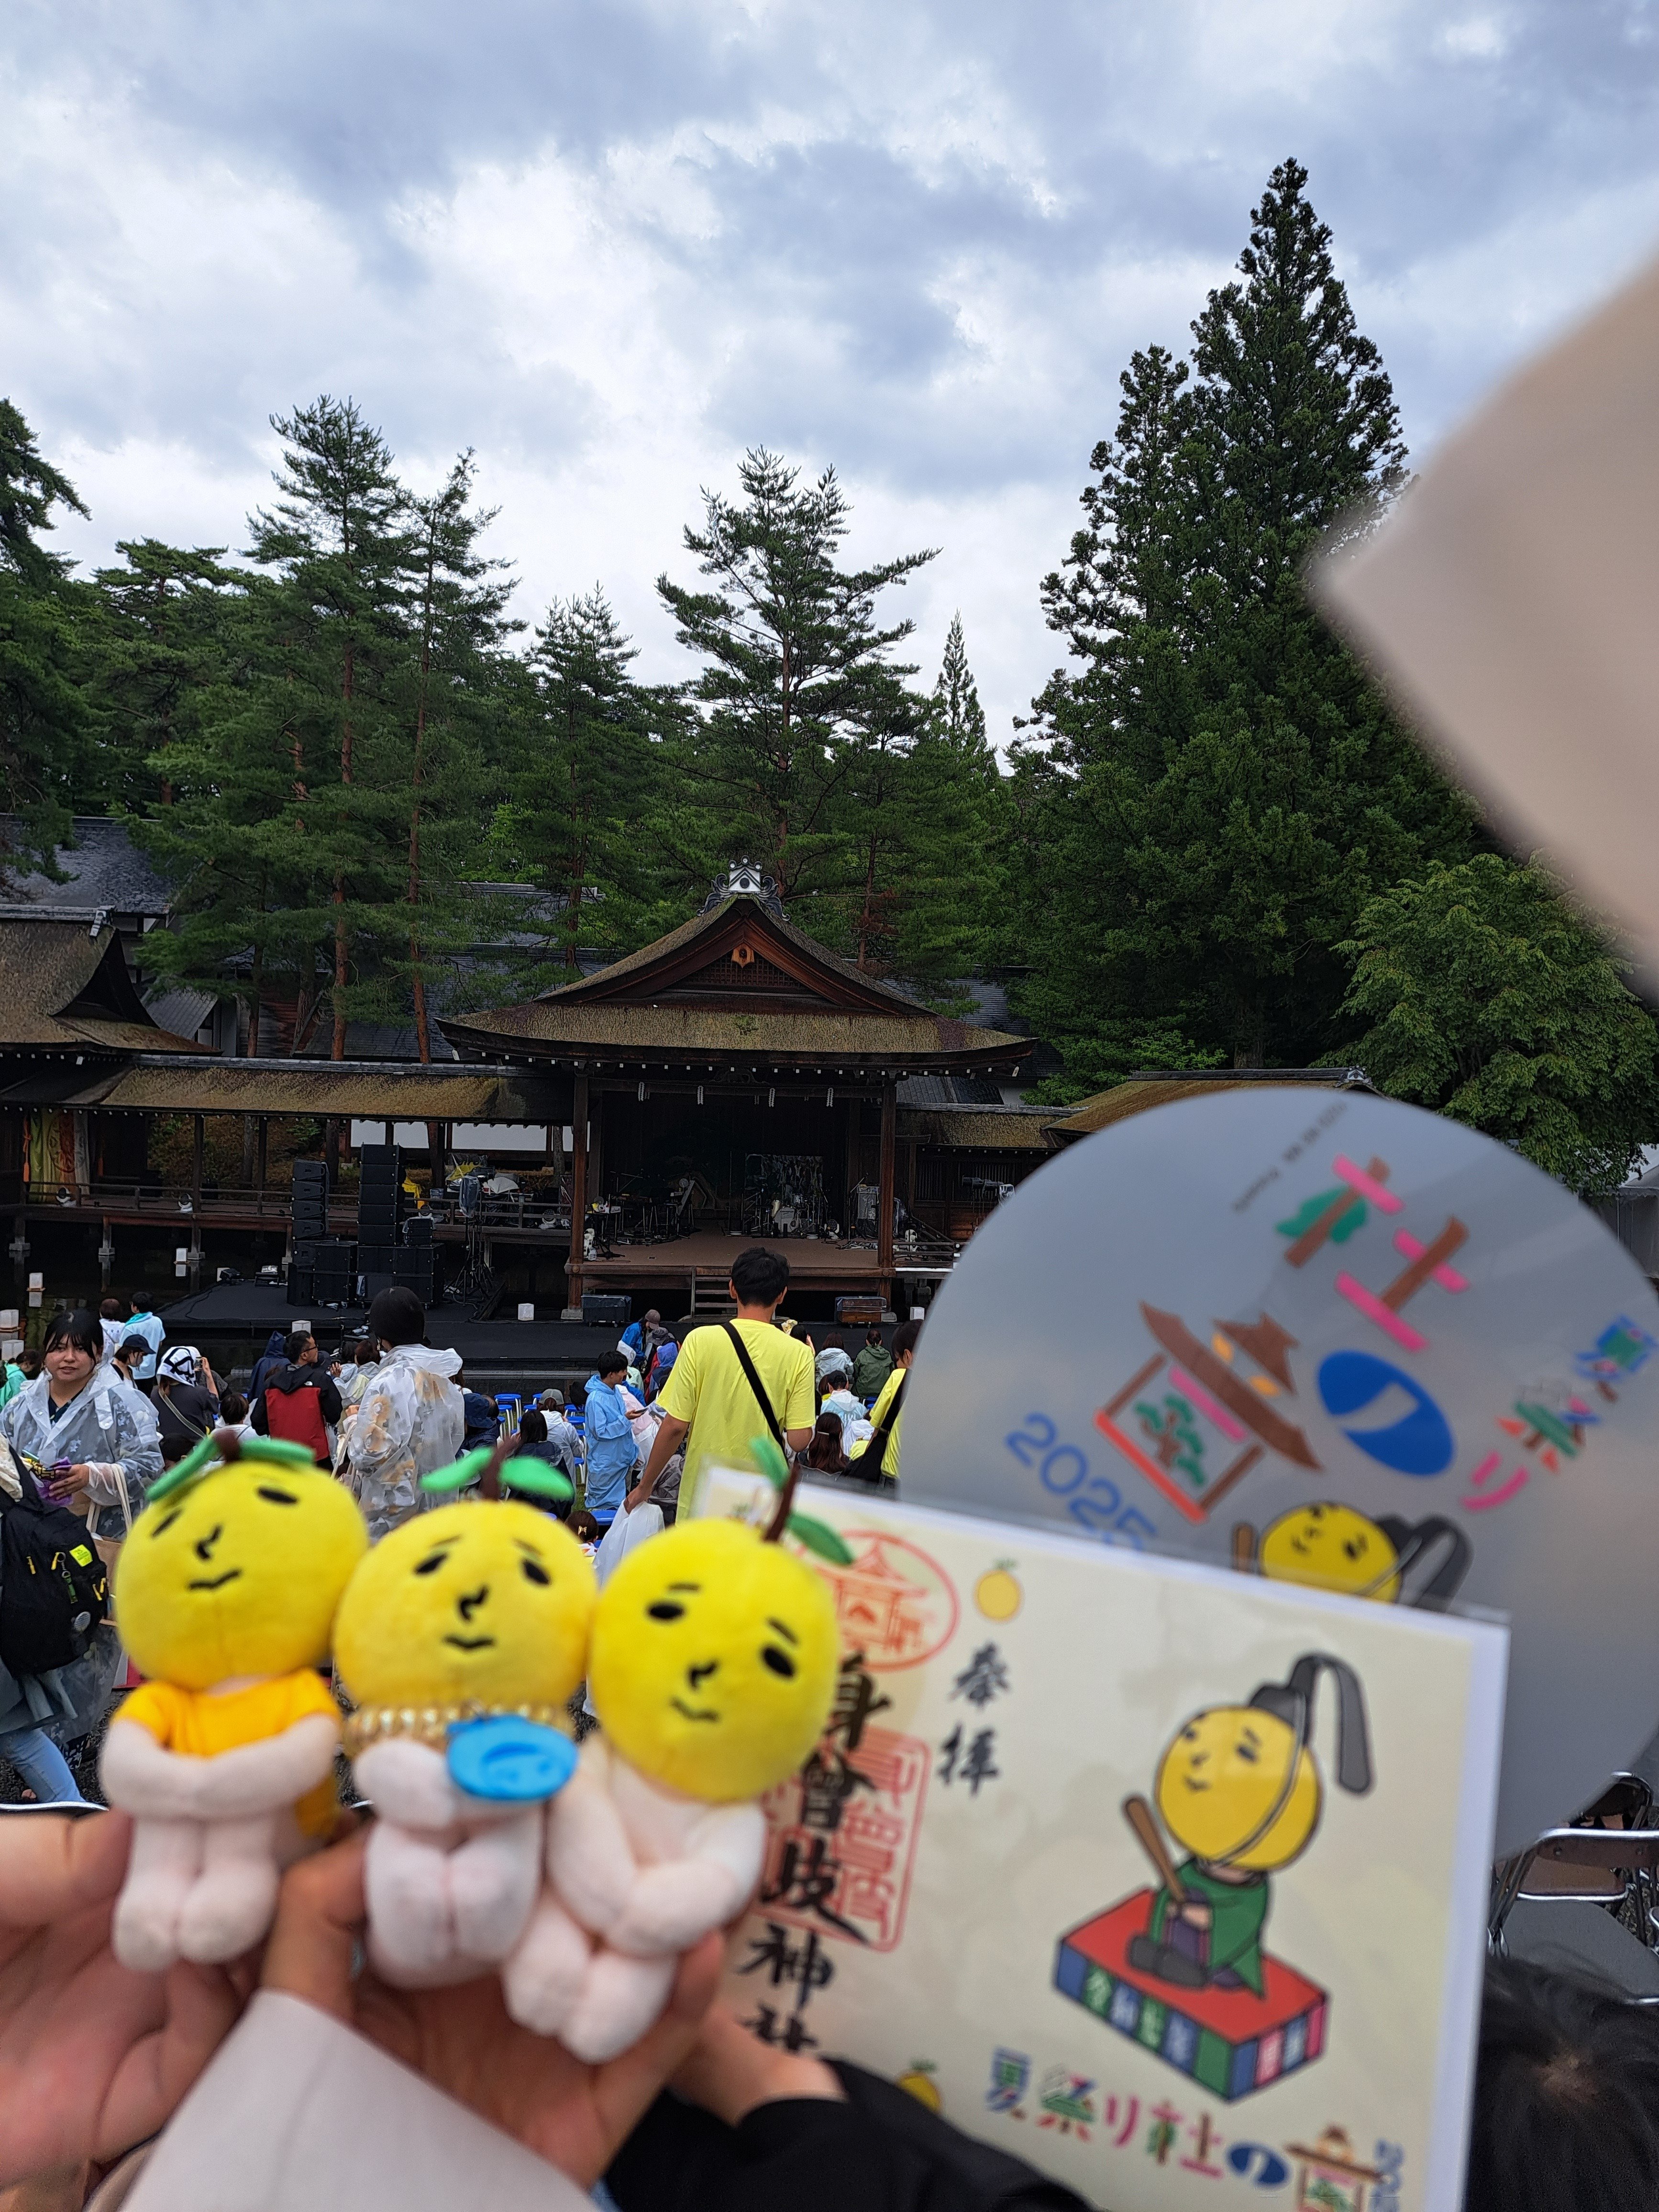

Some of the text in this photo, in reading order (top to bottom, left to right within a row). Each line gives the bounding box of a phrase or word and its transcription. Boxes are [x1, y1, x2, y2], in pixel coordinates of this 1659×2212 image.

[1006, 1411, 1157, 1551] 2025
[1460, 1314, 1658, 1512] 夏祭り
